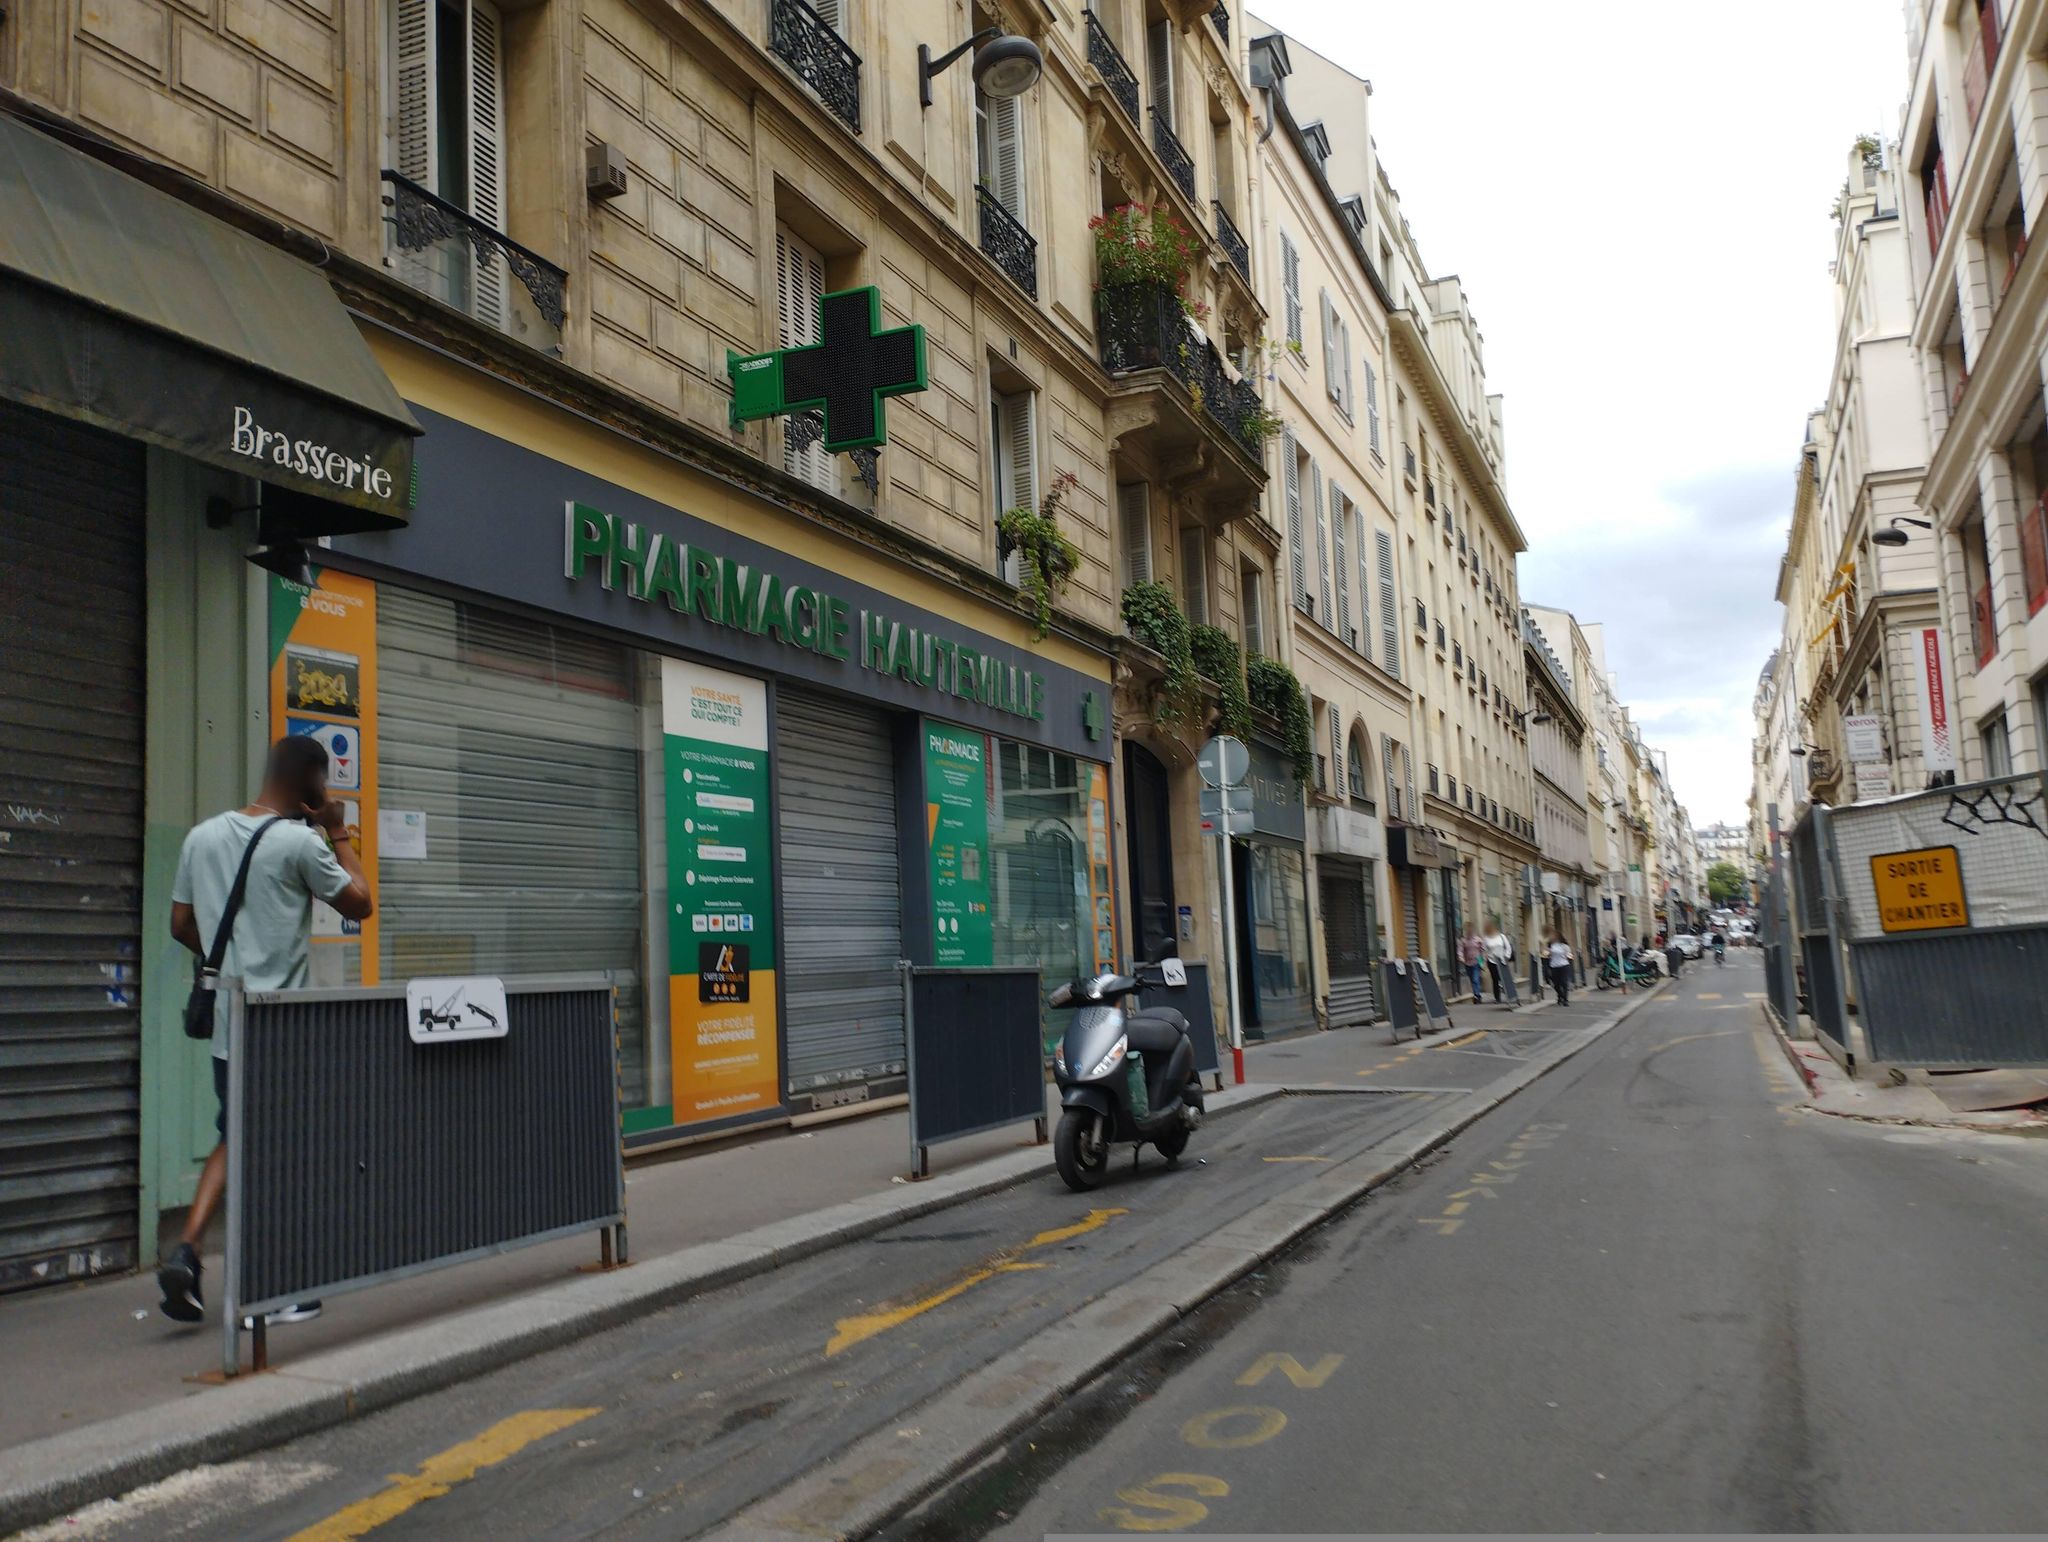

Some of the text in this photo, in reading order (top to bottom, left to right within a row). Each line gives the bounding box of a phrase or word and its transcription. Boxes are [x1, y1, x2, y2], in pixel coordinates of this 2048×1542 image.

[231, 405, 392, 499] Brasserie
[311, 598, 346, 617] VOUS
[563, 500, 1045, 721] PHARMACIE HAUTEVILLE
[690, 685, 716, 701] VOTRE
[690, 708, 706, 720] QUI
[706, 711, 738, 727] COMPTE
[713, 701, 732, 714] TOUT
[733, 705, 743, 717] CE
[929, 734, 980, 762] PHARMACIE
[1887, 857, 1942, 878] SORTIE
[1908, 883, 1930, 899] DE
[1885, 901, 1961, 924] CHANTIER
